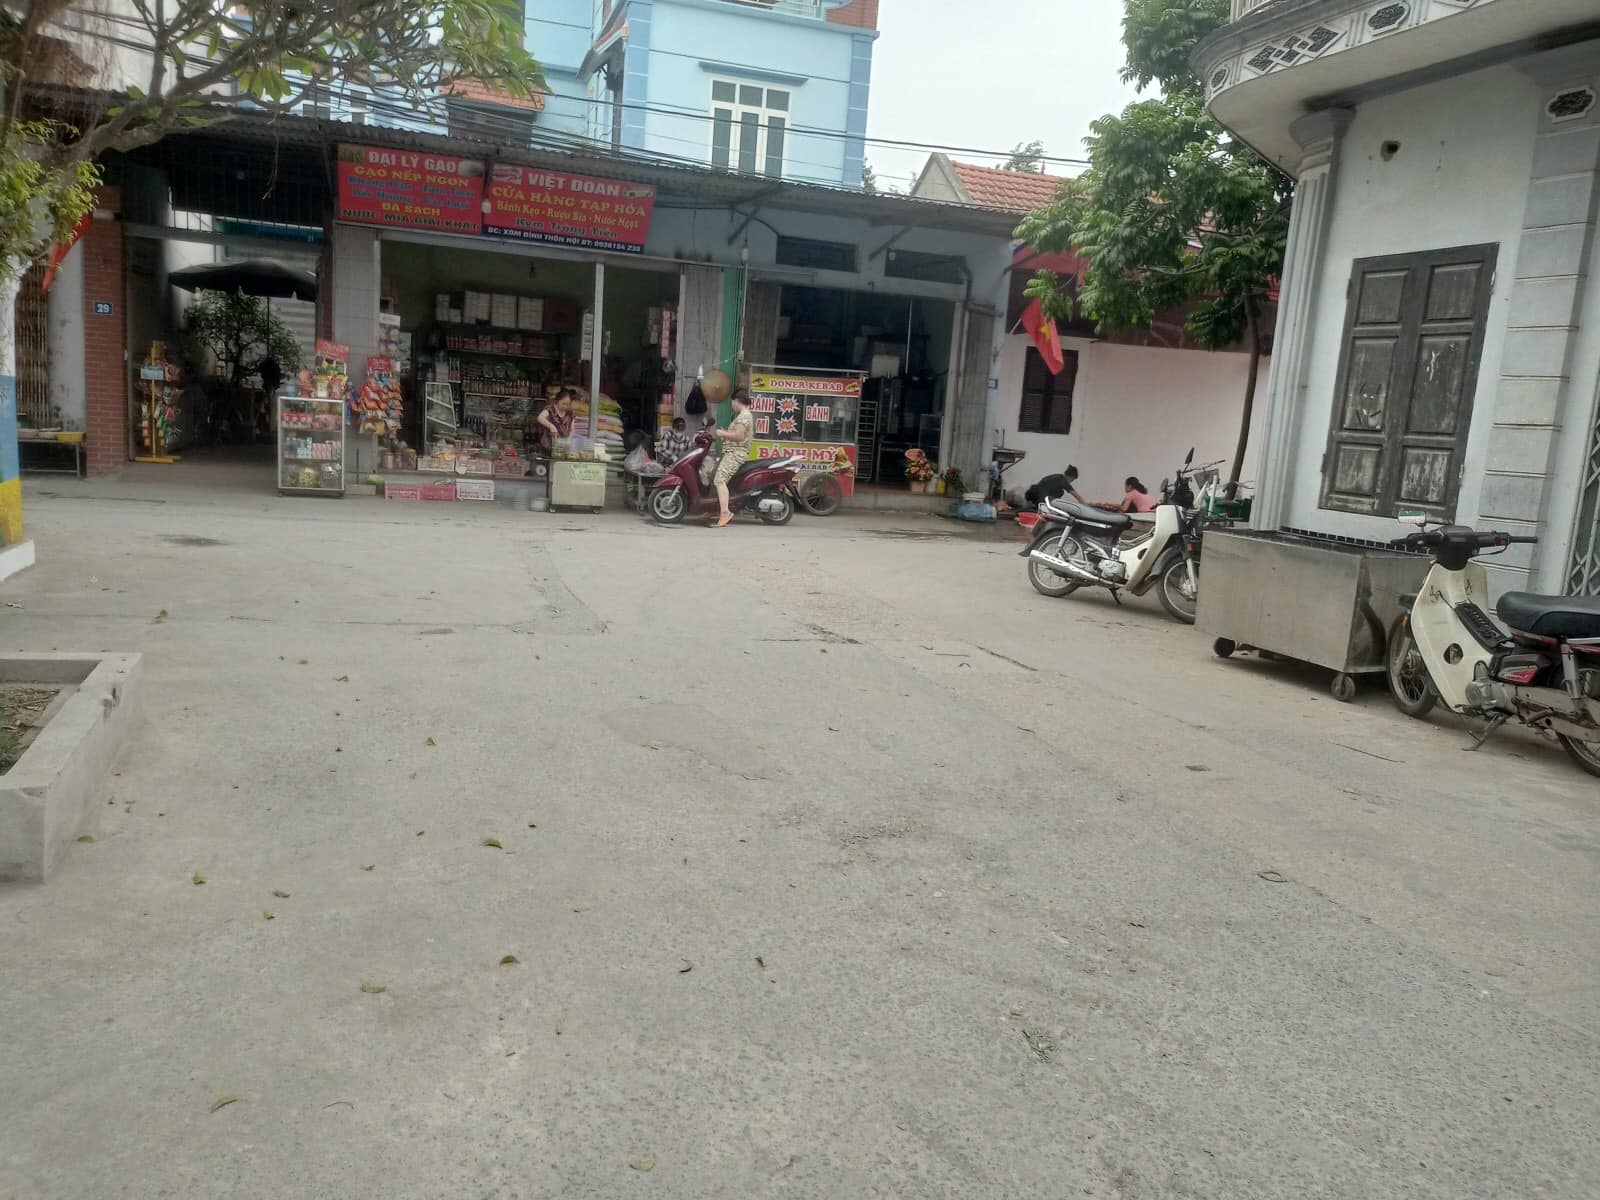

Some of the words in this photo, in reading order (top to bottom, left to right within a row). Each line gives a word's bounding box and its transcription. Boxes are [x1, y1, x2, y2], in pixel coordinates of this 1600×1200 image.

[369, 151, 396, 167] ĐẠI
[401, 154, 418, 168] LÝ
[424, 159, 457, 174] GẠO
[528, 172, 566, 190] VIỆT
[492, 185, 525, 200] CỬA
[531, 191, 576, 208] HÀNG
[580, 200, 610, 213] TẠP
[497, 200, 520, 213] Bánh
[573, 211, 587, 222] Bia
[97, 303, 110, 313] 29
[770, 379, 805, 389] DONER
[808, 381, 843, 391] KEBAB
[806, 403, 830, 422] BÁNH
